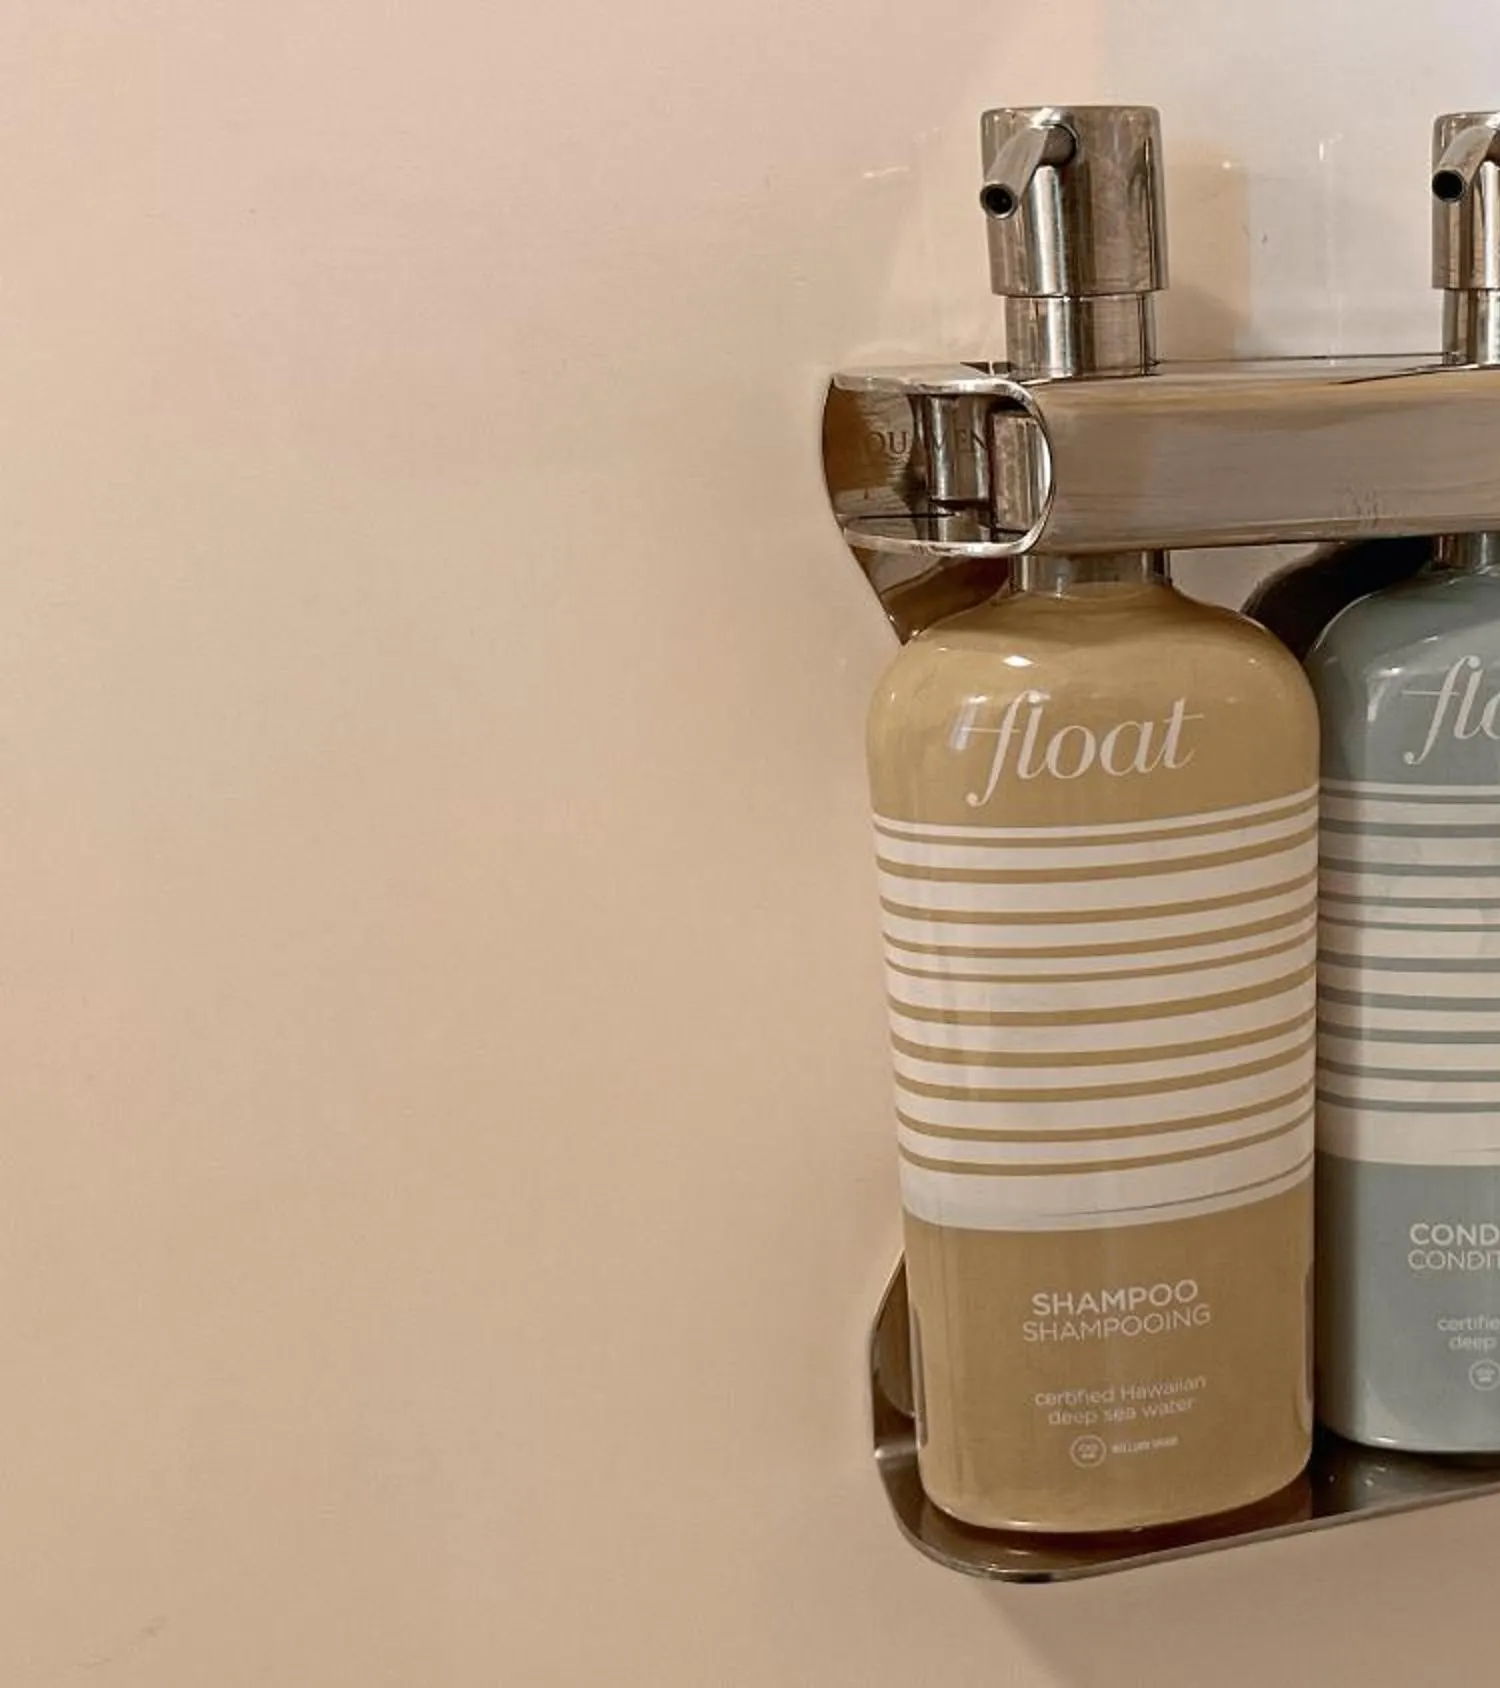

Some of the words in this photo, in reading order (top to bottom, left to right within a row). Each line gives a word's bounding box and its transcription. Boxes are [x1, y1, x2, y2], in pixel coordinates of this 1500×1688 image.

[962, 689, 1204, 807] float
[1031, 1279, 1198, 1316] SHAMPOO
[1022, 1303, 1211, 1341] SHAMPOOING
[1449, 1333, 1496, 1352] deep
[1035, 1386, 1115, 1406] certified
[1120, 1375, 1206, 1401] Hawaiian
[1048, 1408, 1097, 1426] deep
[1104, 1406, 1136, 1421] sea
[1142, 1398, 1196, 1418] water
